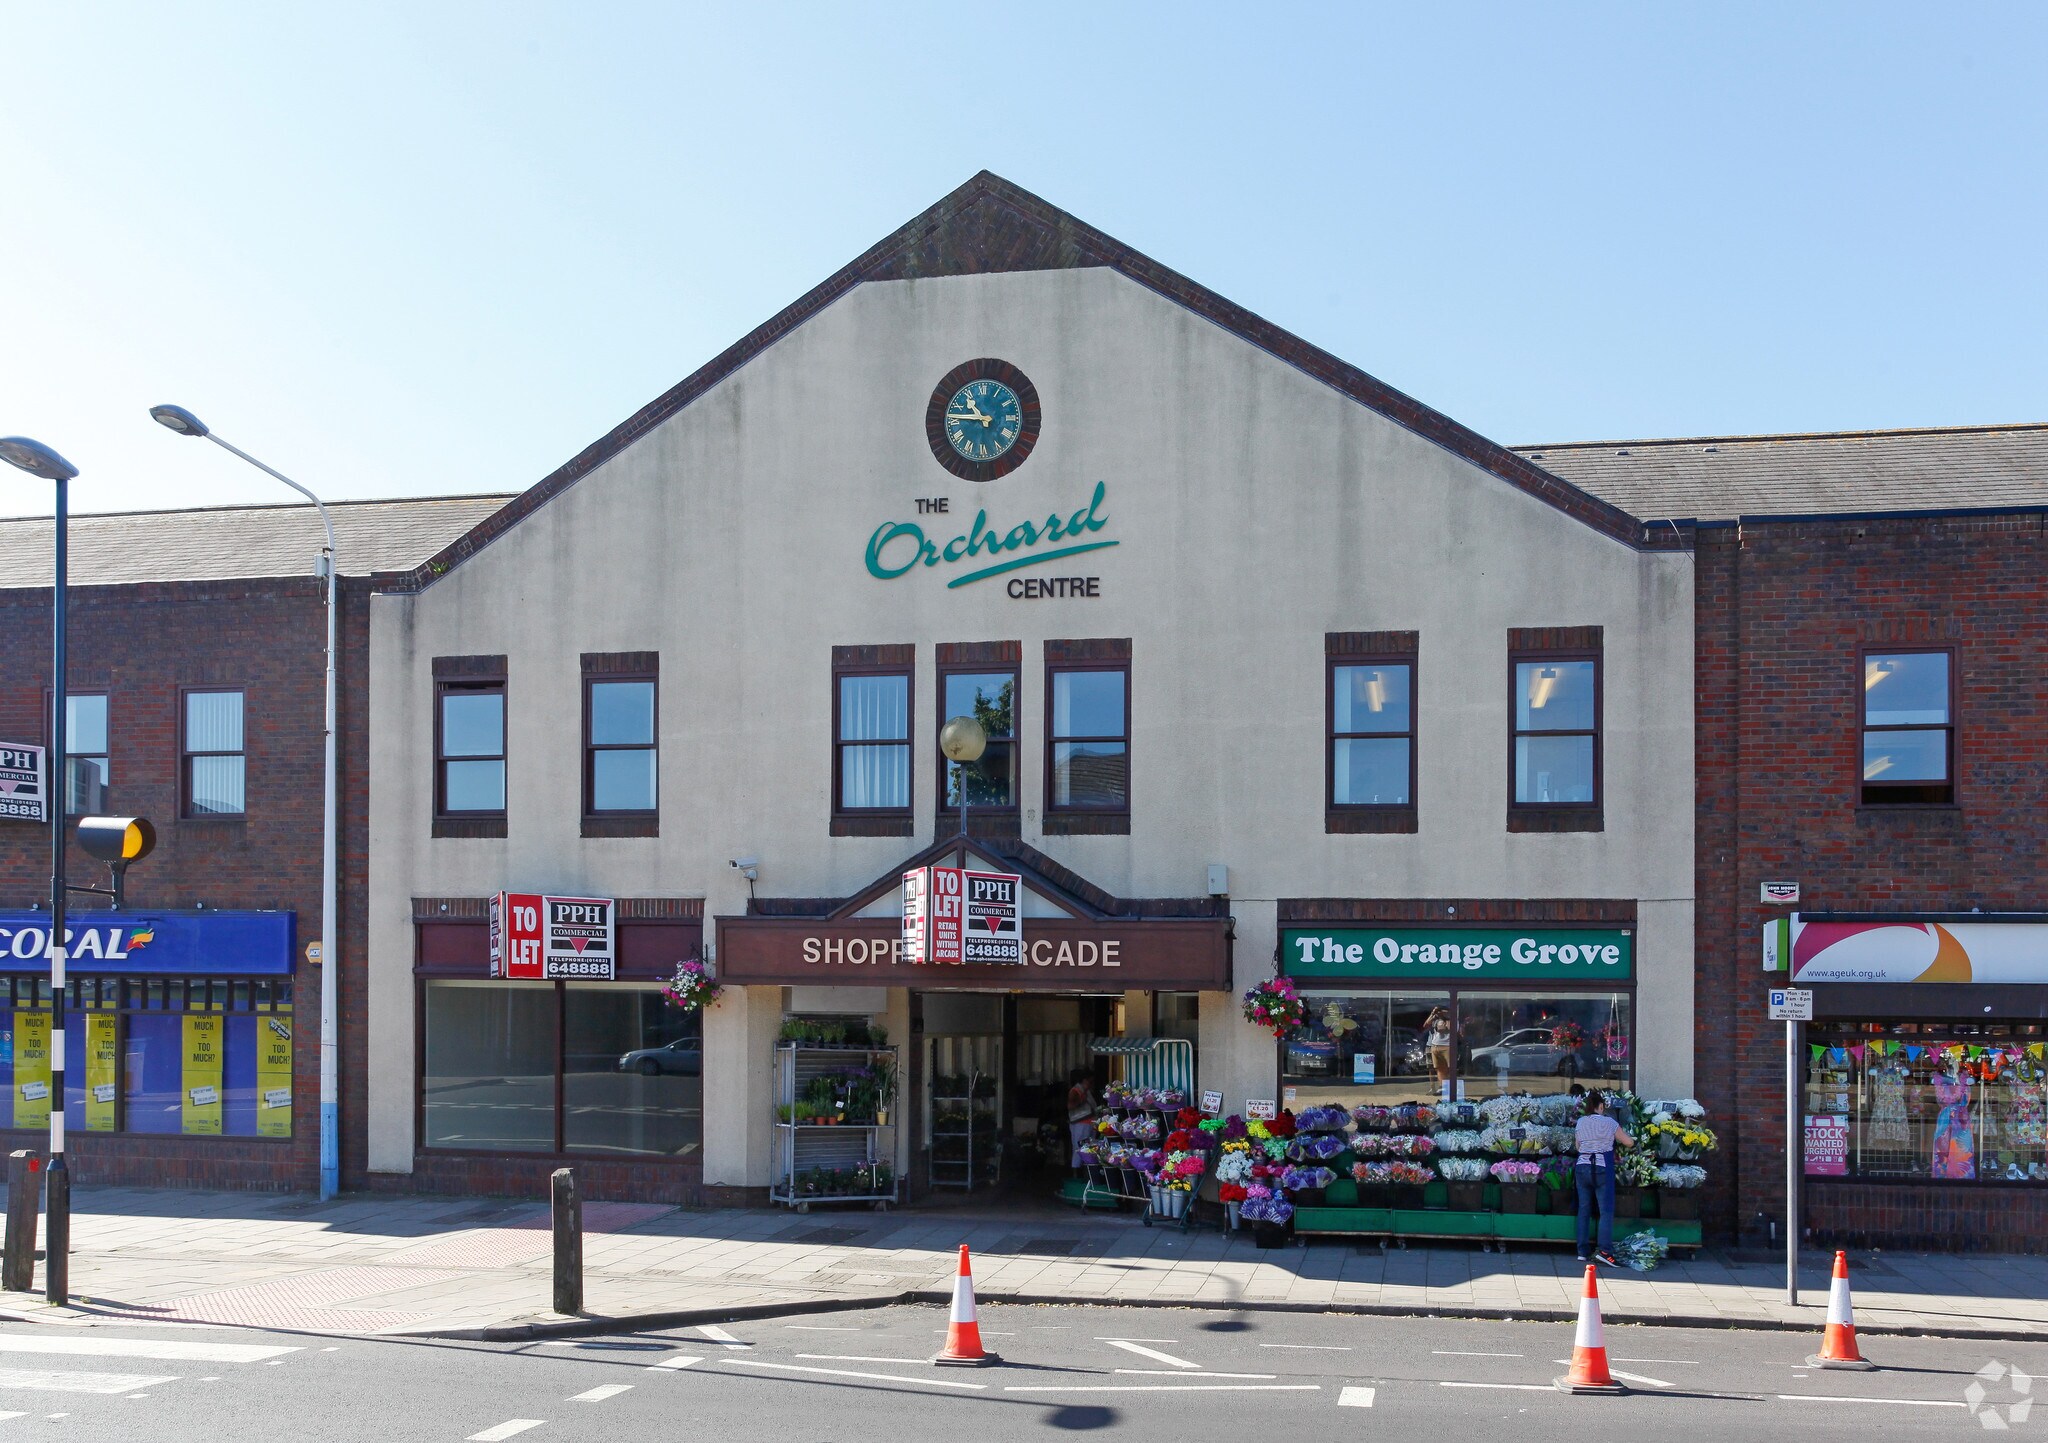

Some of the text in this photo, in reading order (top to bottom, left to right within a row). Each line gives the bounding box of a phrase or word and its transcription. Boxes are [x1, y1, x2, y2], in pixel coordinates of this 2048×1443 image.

[914, 497, 949, 514] THE
[865, 480, 1111, 580] Orchard
[1006, 576, 1100, 600] CENTRE
[936, 871, 959, 895] TO
[973, 880, 1011, 902] PPH
[934, 894, 961, 918] LET
[556, 904, 601, 924] PPH
[970, 906, 1014, 917] COMMERCIAL
[513, 906, 537, 932] TO
[937, 921, 958, 931] RETAIL
[553, 928, 605, 938] COMMERCIAL
[938, 930, 957, 940] UNITS
[936, 940, 959, 949] WITHIN
[511, 939, 540, 965] LET
[935, 949, 959, 959] ARCADE
[966, 945, 1018, 957] 648888
[1296, 937, 1620, 970] The Orange Grove
[548, 963, 610, 974] 648888
[1807, 969, 1887, 979] www.ageuk.org.uk
[25, 1018, 44, 1028] MUCH
[194, 1021, 214, 1030] MUCH
[28, 1039, 41, 1048] TOO
[102, 1040, 115, 1049] TOO
[198, 1042, 211, 1051] TOO
[272, 1044, 285, 1053] TOO
[24, 1049, 46, 1059] MUCH?
[193, 1053, 216, 1063] MUCH?
[267, 1055, 290, 1065] MUCH?
[1805, 1128, 1843, 1139] STOCK
[1805, 1139, 1844, 1147] WANTED
